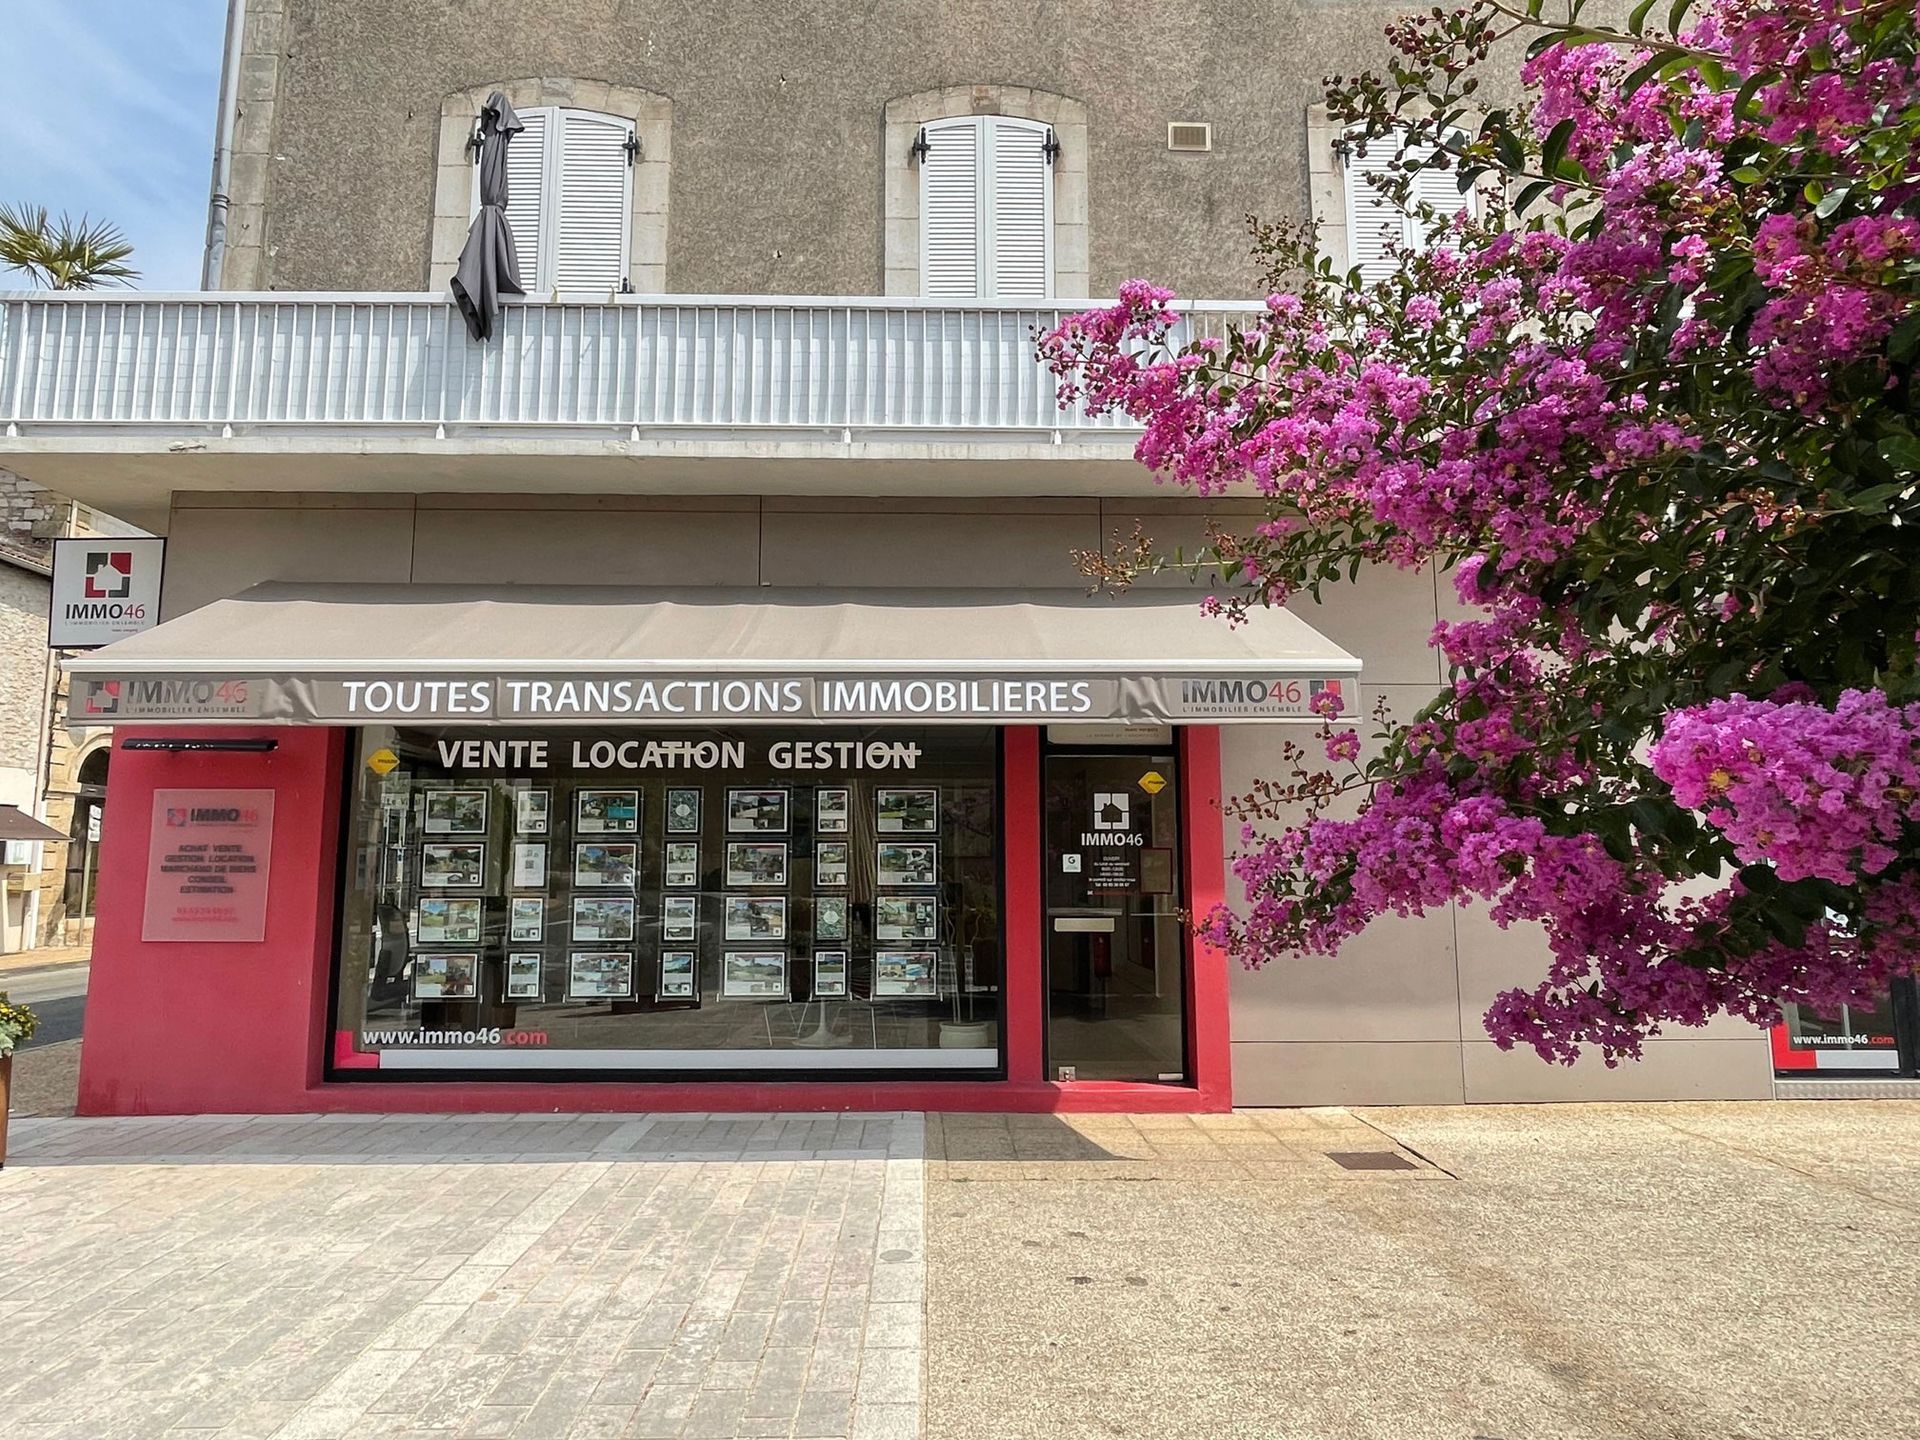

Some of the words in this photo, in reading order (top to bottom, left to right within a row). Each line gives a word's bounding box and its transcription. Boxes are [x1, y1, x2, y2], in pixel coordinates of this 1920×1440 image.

[65, 603, 146, 620] IMMO46
[127, 680, 248, 704] IMMO46
[342, 681, 491, 713] TOUTES
[506, 681, 803, 713] TRANSACTIONS
[822, 681, 1092, 713] IMMOBILIERES
[1182, 680, 1302, 703] IMMO46
[1253, 705, 1302, 713] ENSEMBLE
[437, 740, 548, 769] VENTE
[572, 740, 745, 769] LOCATION
[768, 741, 917, 769] GESTION
[1081, 832, 1144, 847] IMMO46
[363, 1026, 548, 1045] www.immo46.com
[1793, 1033, 1895, 1045] www.immo46.com
